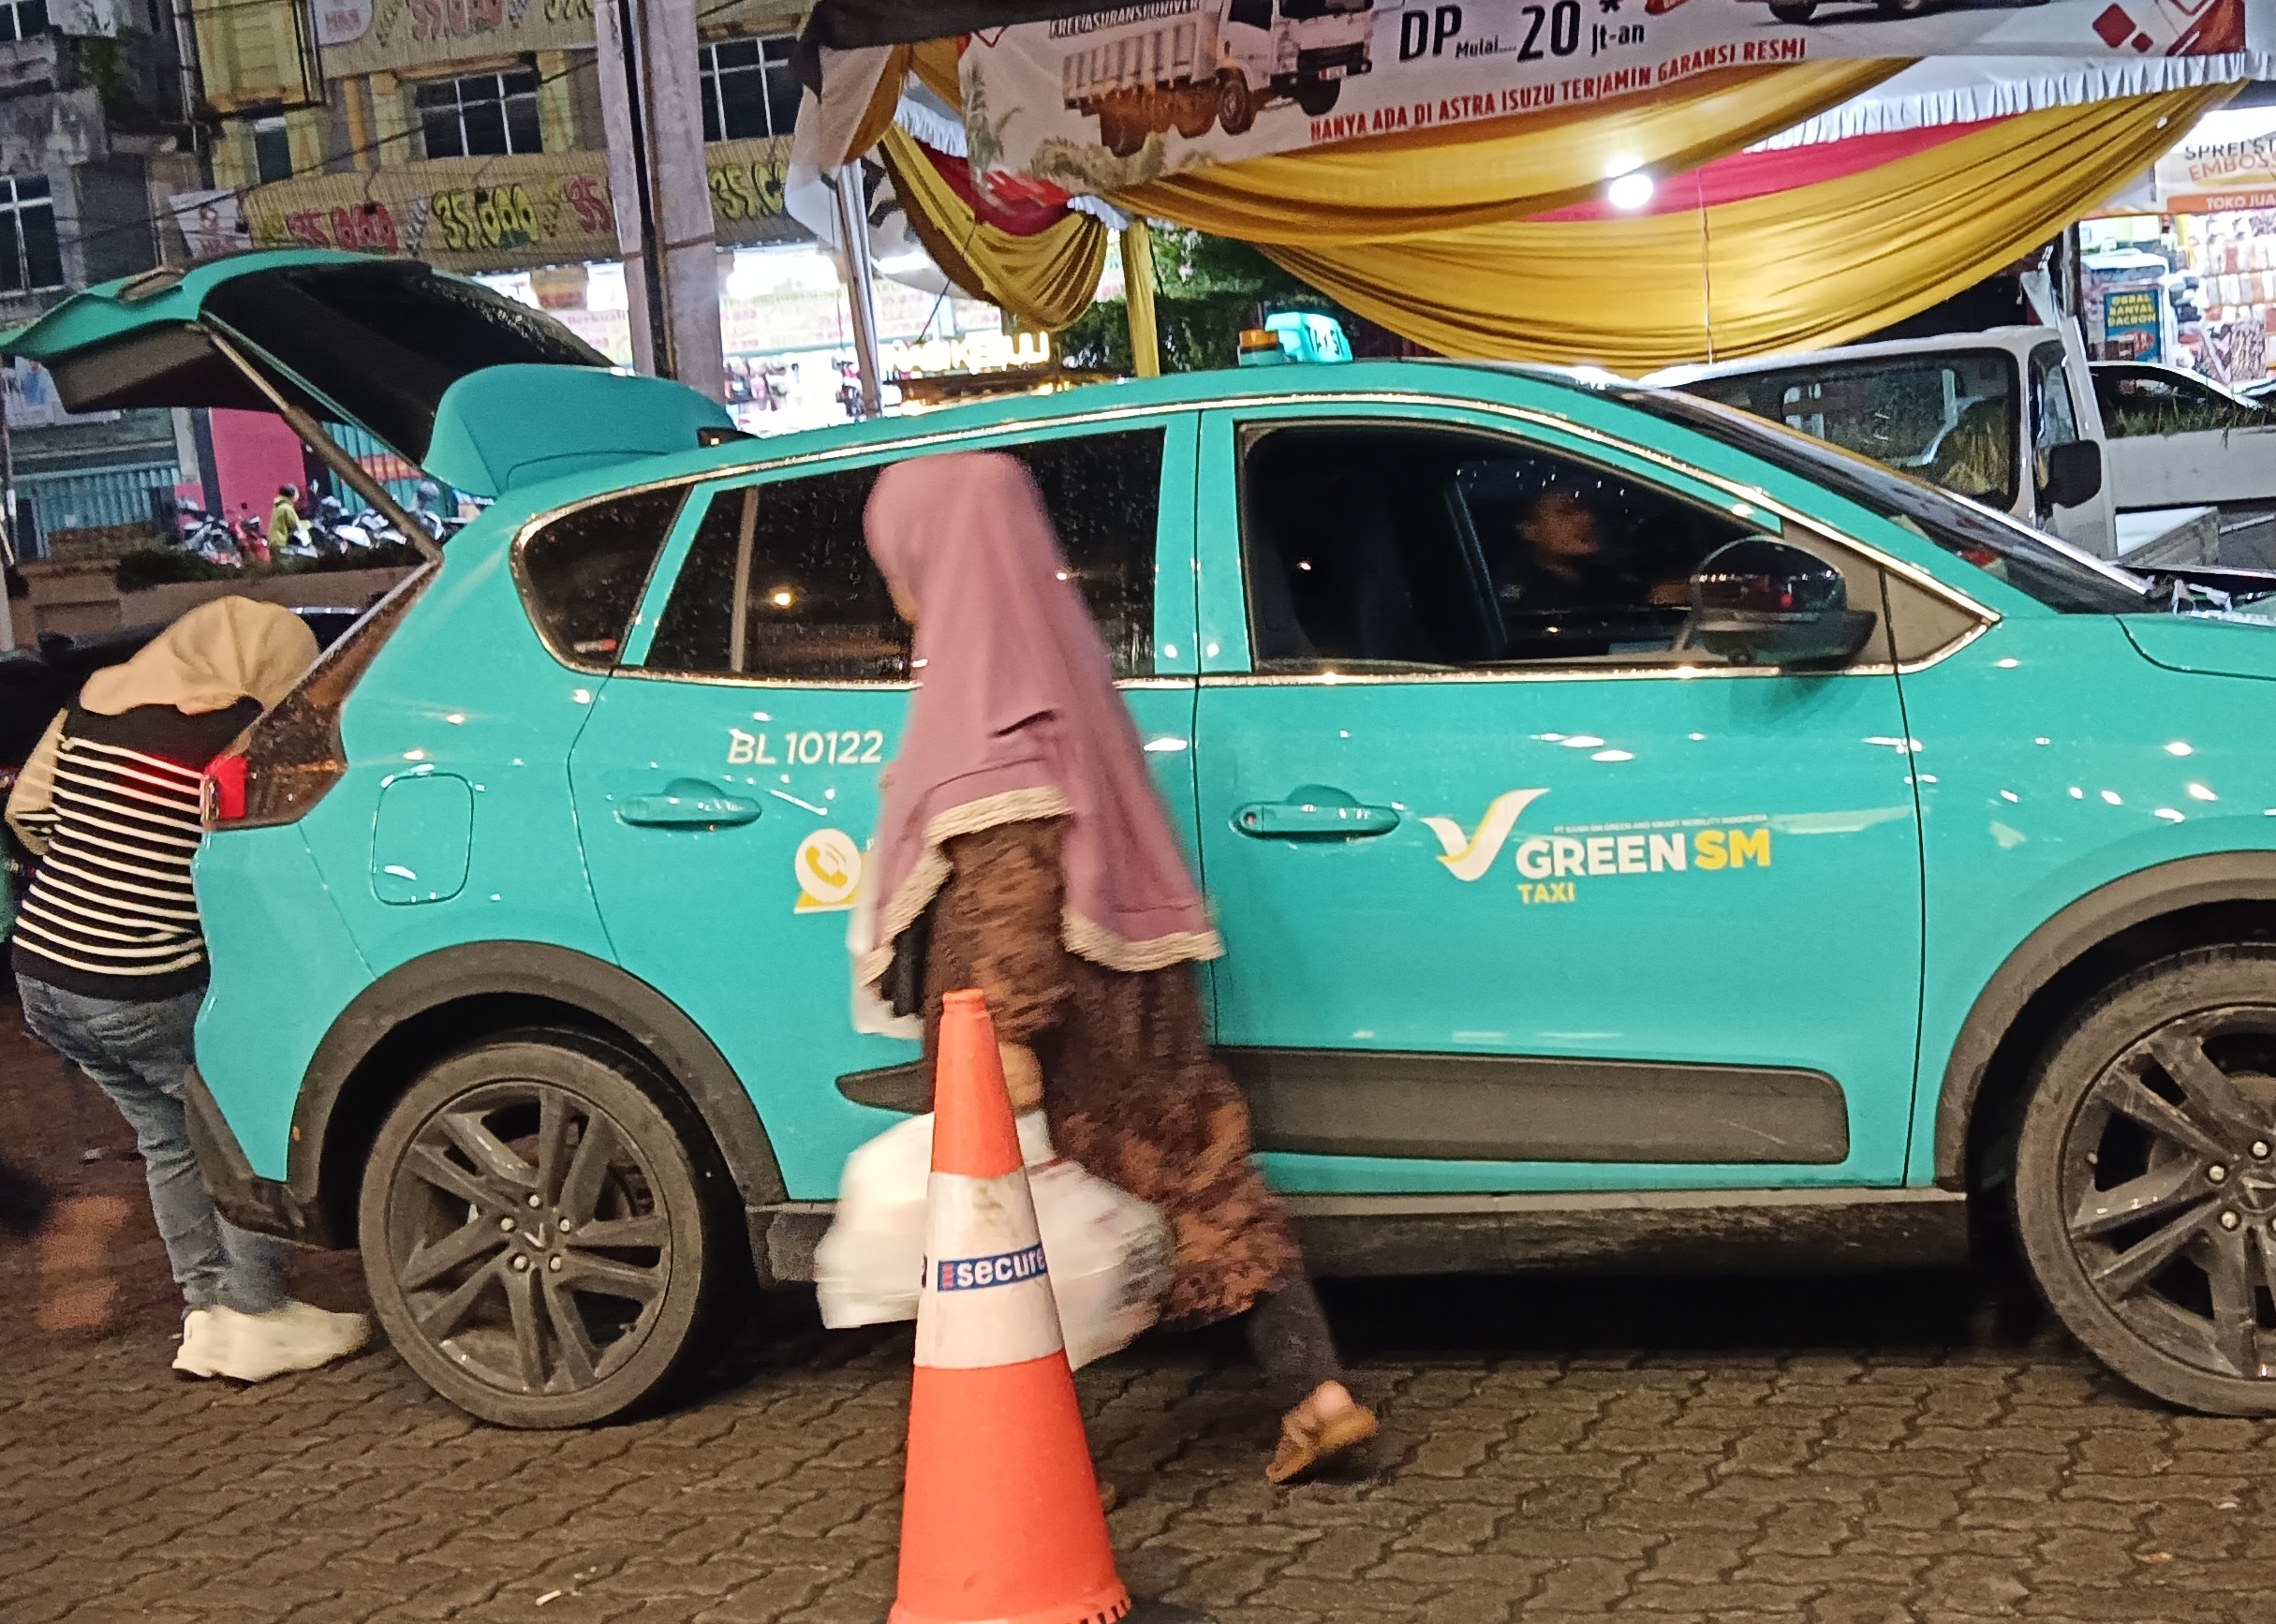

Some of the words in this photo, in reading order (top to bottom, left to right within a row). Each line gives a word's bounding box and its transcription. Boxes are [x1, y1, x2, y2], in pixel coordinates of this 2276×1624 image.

[1399, 4, 1462, 62] DP
[1517, 1, 1580, 62] 20
[1310, 112, 1367, 141] HANYA
[1373, 96, 1408, 130] ADA
[1414, 94, 1432, 125] DI
[1440, 91, 1496, 121] ASTRA
[1501, 82, 1555, 111] ISUZU
[1561, 66, 1651, 100] TERJAMIN
[1657, 43, 1736, 82] GARANSI
[1743, 37, 1806, 62] RESMI
[432, 184, 539, 252] 35.000
[2206, 195, 2246, 211] TOKO
[728, 731, 776, 764] BL
[785, 730, 883, 765] 10122
[1515, 833, 1687, 879] GREEN
[1694, 829, 1771, 870] SM
[1517, 881, 1575, 904] TAXI
